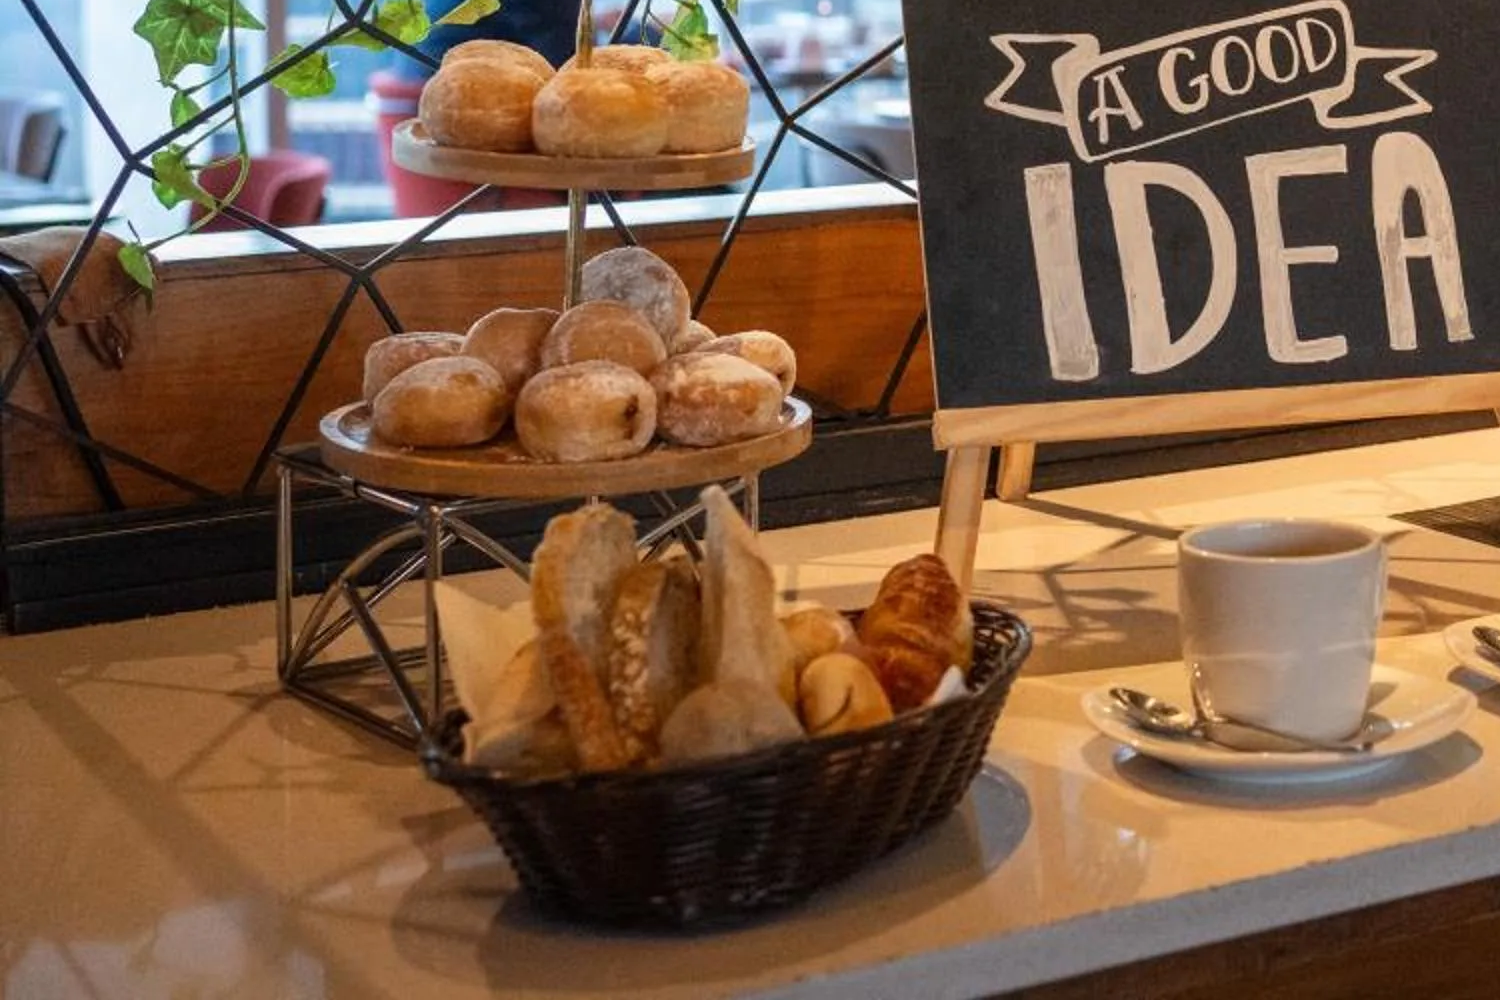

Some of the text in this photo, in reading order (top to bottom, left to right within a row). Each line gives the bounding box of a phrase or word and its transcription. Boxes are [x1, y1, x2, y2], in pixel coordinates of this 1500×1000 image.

[1089, 16, 1338, 143] A GOOD
[1024, 131, 1475, 382] IDEA
